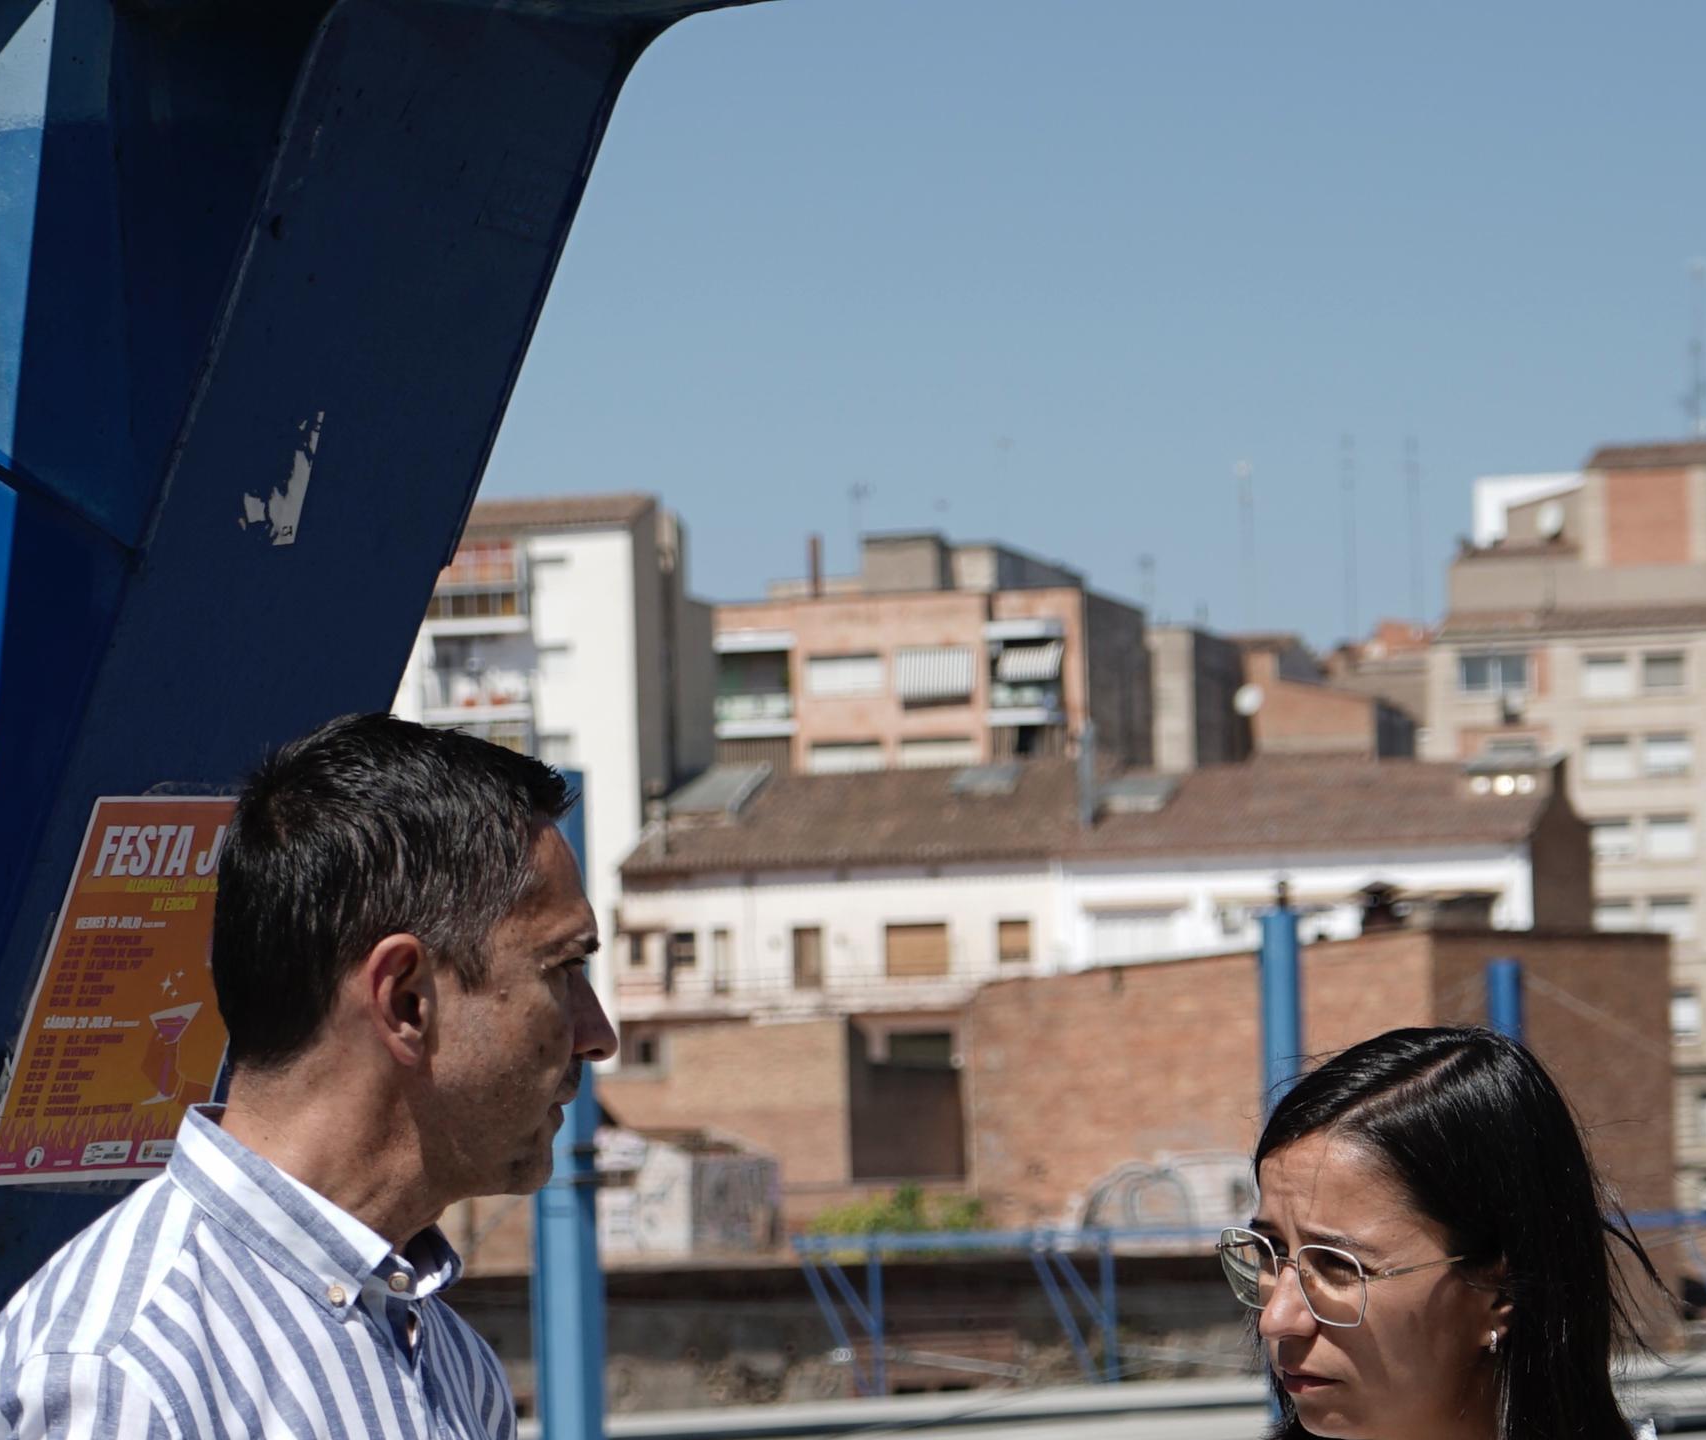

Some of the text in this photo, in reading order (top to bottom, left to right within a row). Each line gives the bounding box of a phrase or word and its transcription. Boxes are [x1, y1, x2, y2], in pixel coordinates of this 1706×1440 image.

[93, 825, 195, 877] FESTA
[165, 895, 198, 911] EDICIÓN
[76, 917, 107, 930] VIERNES
[108, 917, 118, 929] 19
[119, 917, 142, 929] JULIO
[44, 1014, 76, 1029] SÁBADO
[77, 1016, 89, 1029] 20
[90, 1016, 113, 1029] JULIO
